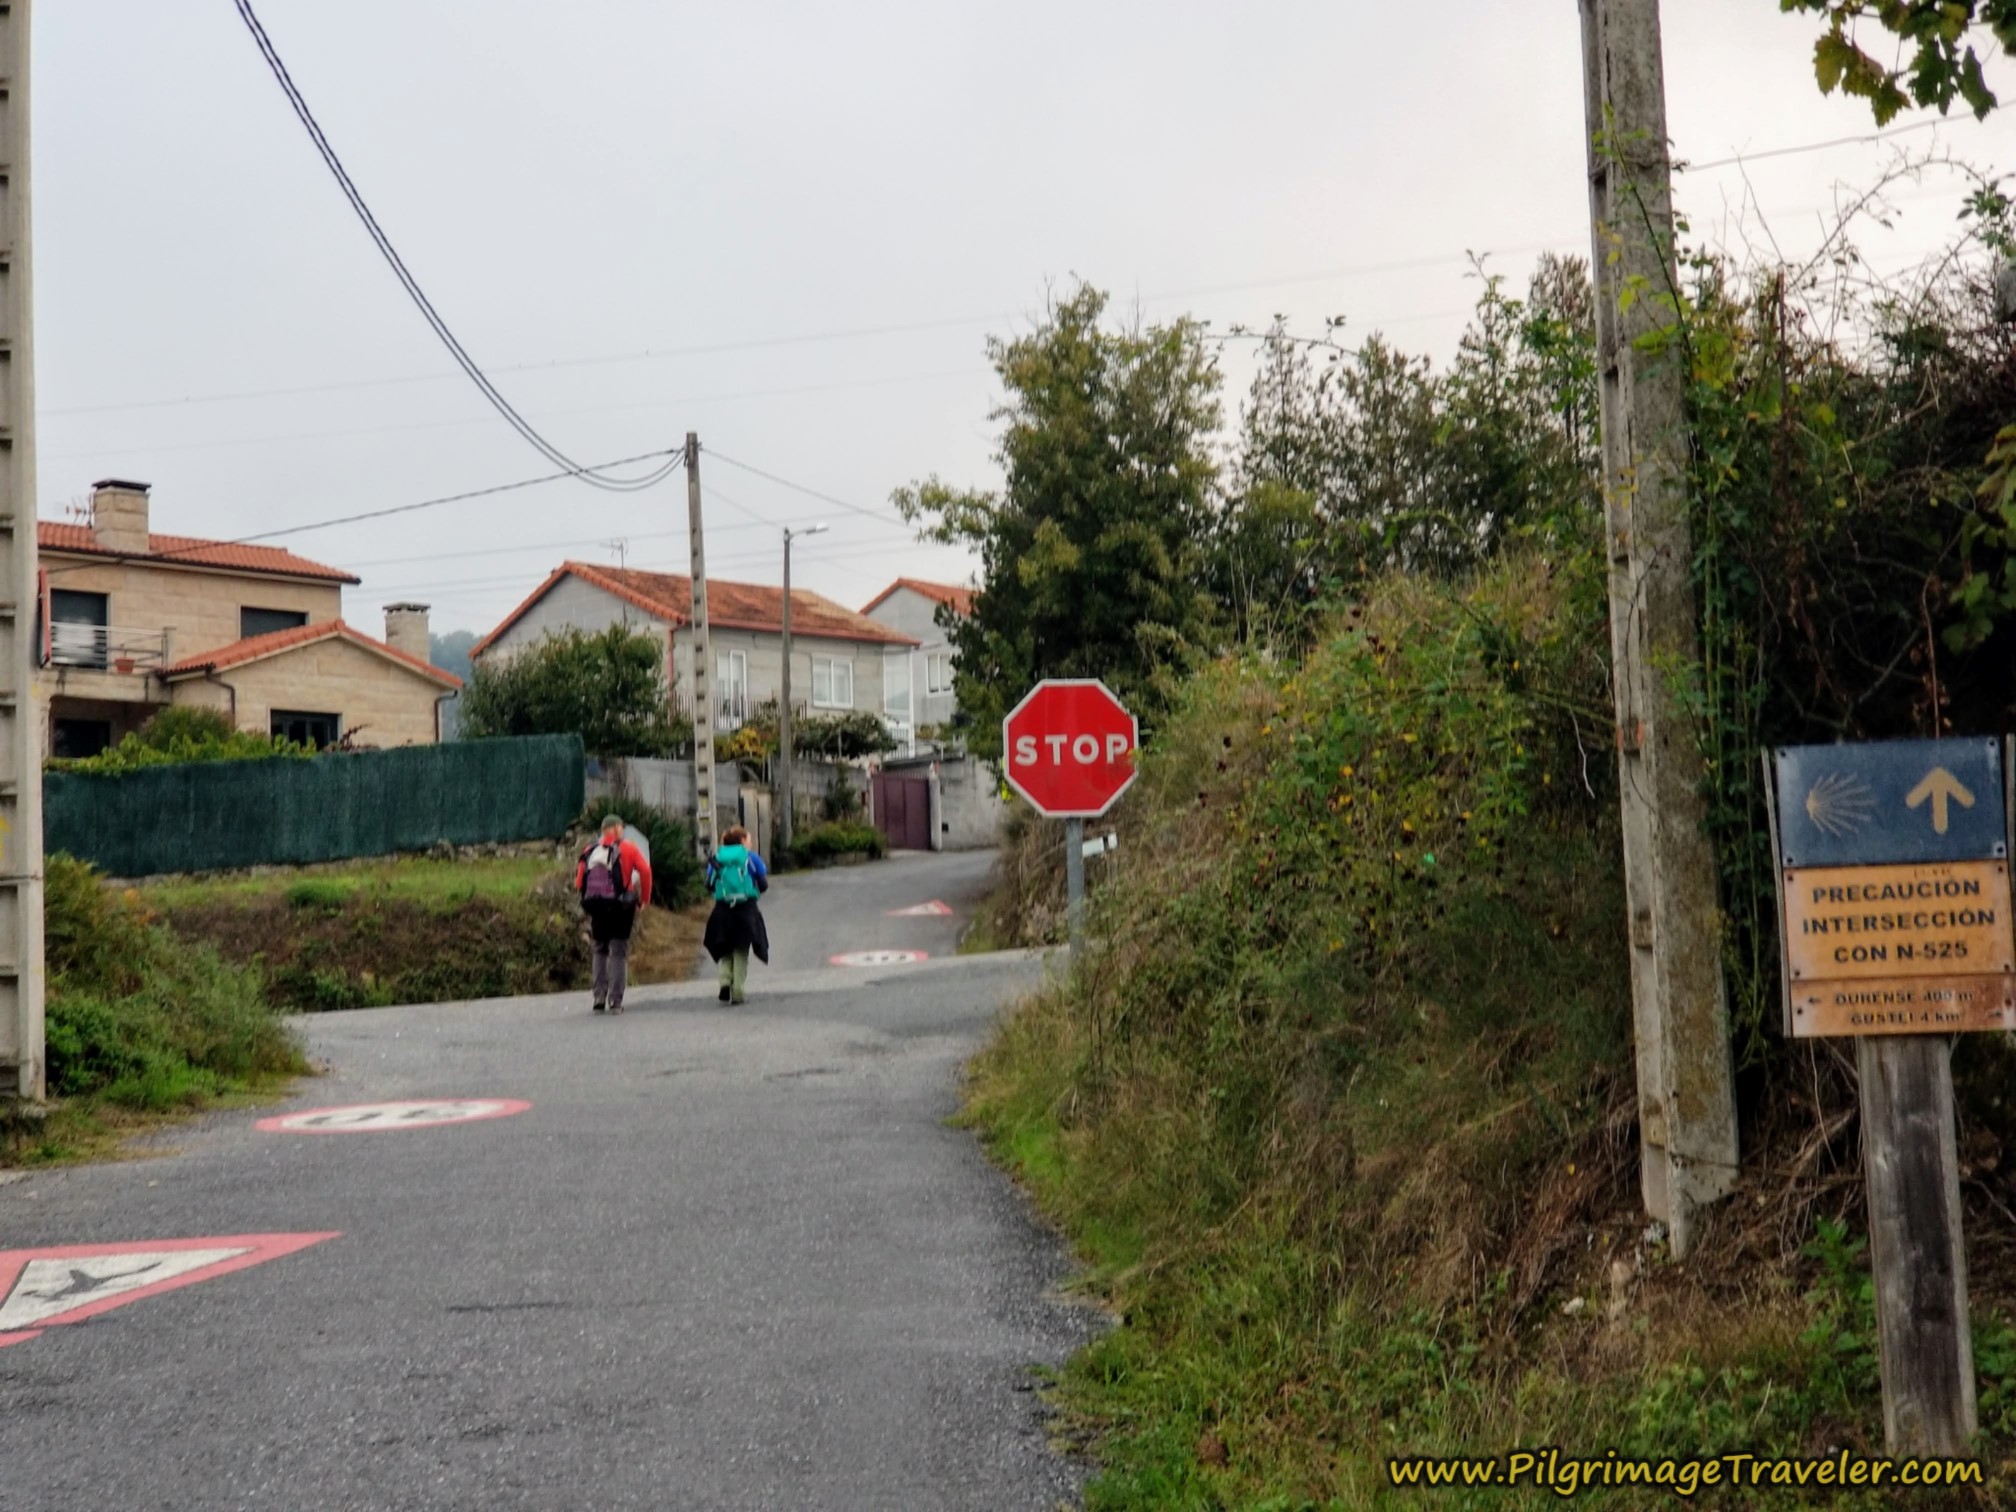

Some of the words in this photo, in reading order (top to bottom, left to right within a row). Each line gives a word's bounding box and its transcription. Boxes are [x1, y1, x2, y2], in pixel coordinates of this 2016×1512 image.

[1015, 733, 1129, 767] STOP
[1812, 878, 1981, 904] PRECAUCIÓN
[1802, 906, 1996, 935] INTERSECCIÓN
[1833, 945, 1888, 964] CON
[1896, 940, 1969, 961] N-525
